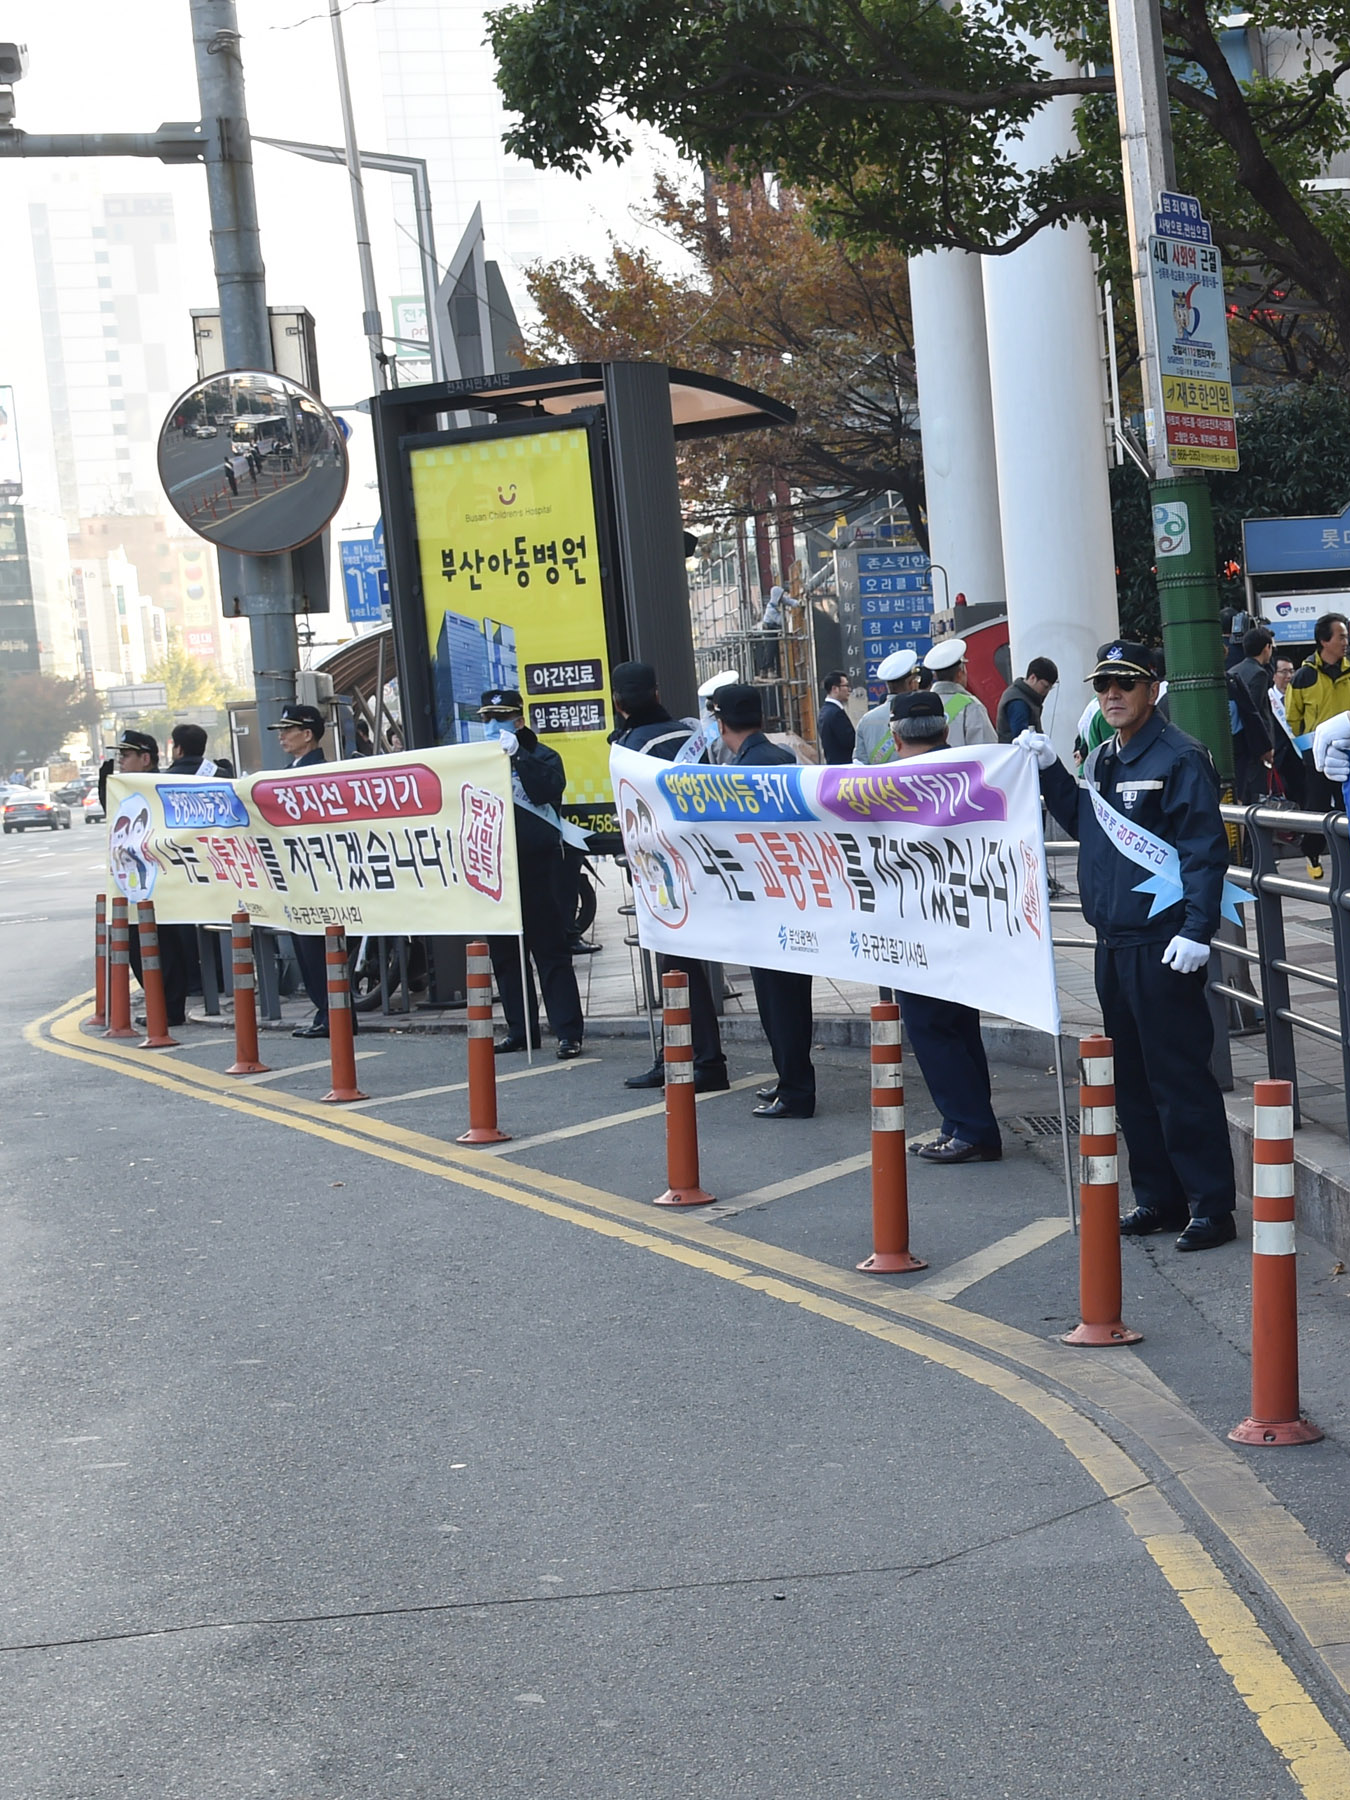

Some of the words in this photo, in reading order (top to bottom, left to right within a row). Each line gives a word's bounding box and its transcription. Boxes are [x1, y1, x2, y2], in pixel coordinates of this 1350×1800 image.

[1162, 198, 1198, 219] 범죄예방
[1154, 241, 1169, 265] 4대
[1172, 244, 1197, 271] 사회악
[1200, 249, 1217, 273] 근절
[446, 374, 512, 394] 전자시민게시판
[465, 513, 488, 523] Busan
[488, 508, 524, 521] Children's
[524, 504, 553, 517] Hospital
[441, 535, 588, 591] 부산아동병원
[842, 581, 855, 591] 9F
[866, 578, 907, 592] 오라클
[844, 602, 857, 612] 8F
[1293, 605, 1316, 614] 부산은행
[846, 624, 859, 634] 7F
[847, 645, 860, 655] 6F
[532, 664, 596, 688] 야간진료
[849, 666, 862, 677] 5F
[534, 704, 601, 729] 일·공휴일진료
[272, 781, 348, 820] 정지선
[347, 773, 423, 812] 지키기
[664, 772, 759, 814] 방향지시등
[757, 772, 801, 815] 켜기
[836, 777, 919, 817] 정지선
[898, 771, 985, 818] 지키기
[155, 837, 209, 885] 나는
[197, 835, 290, 892] 교통질서를
[282, 826, 460, 893] 지키겠습니다!
[677, 832, 756, 902] 나는
[735, 831, 877, 914] 교통질서를
[868, 833, 1021, 937] 지키겠습니다!
[291, 906, 364, 925] 유공친절기사회
[788, 928, 819, 947] 부산광역시
[861, 932, 929, 970] 유공친절기사회
